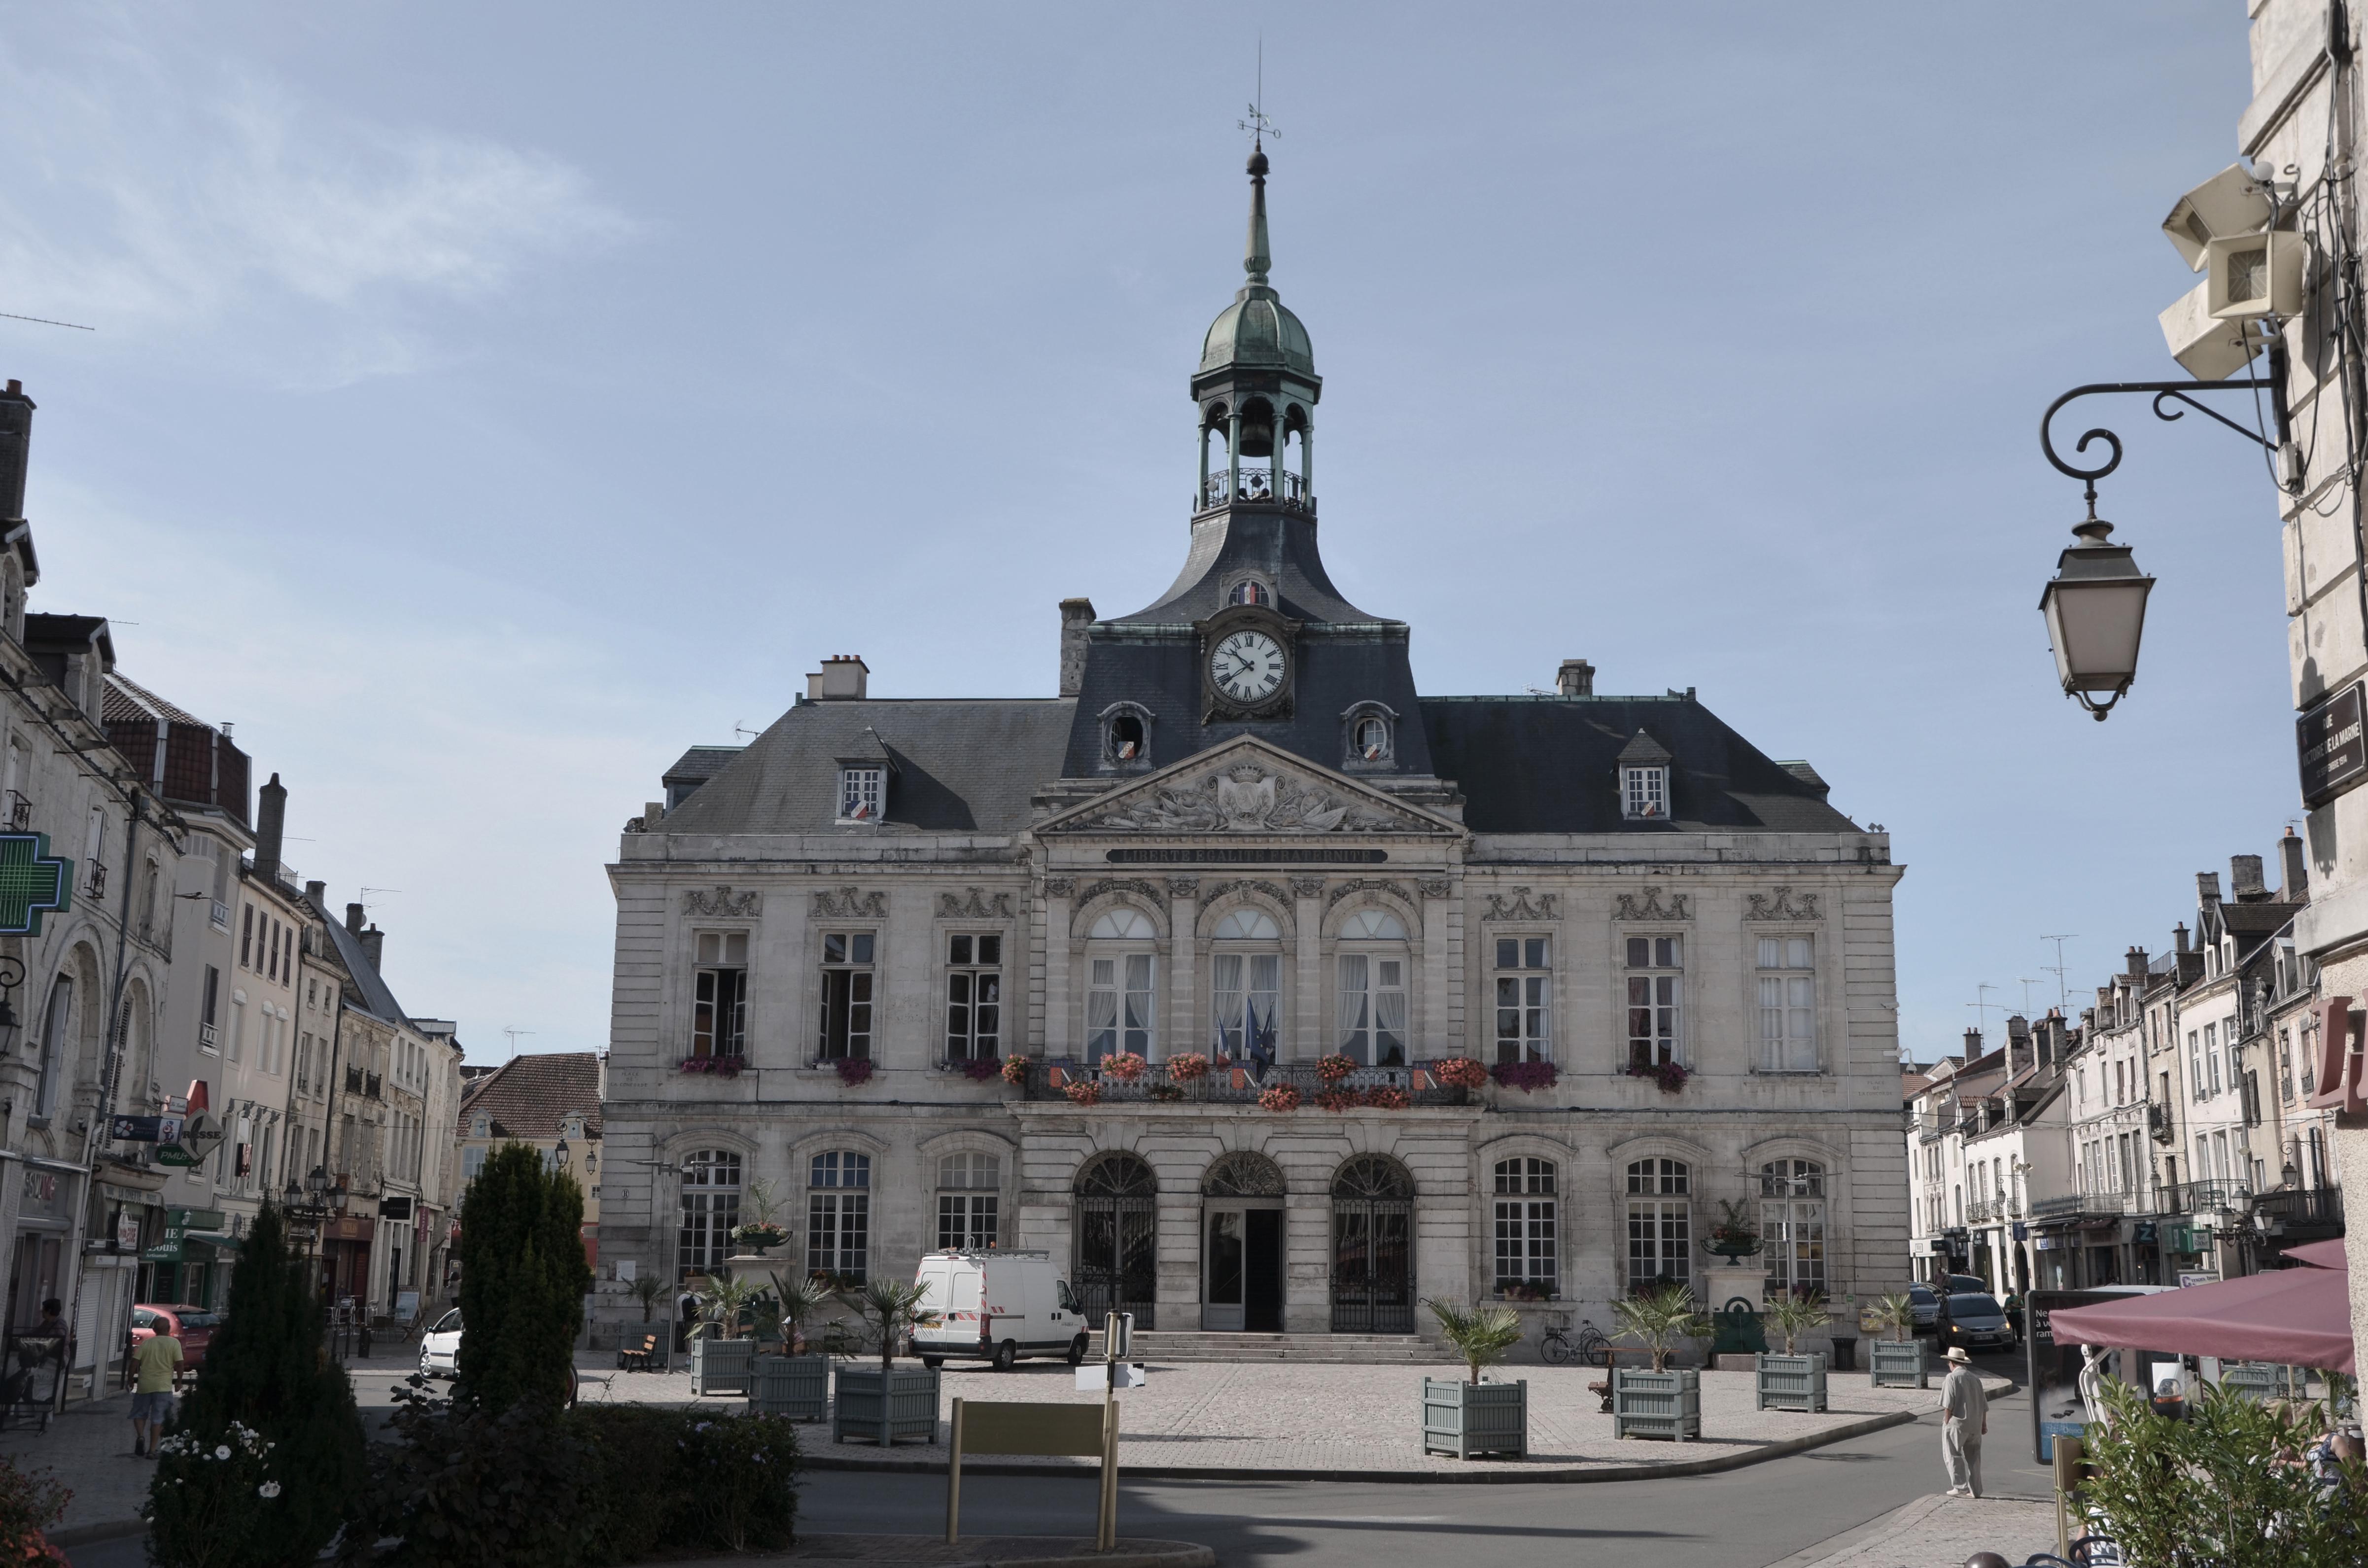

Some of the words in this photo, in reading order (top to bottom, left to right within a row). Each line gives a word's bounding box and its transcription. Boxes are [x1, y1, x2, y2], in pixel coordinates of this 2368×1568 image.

[2322, 713, 2333, 731] RUE
[2302, 741, 2325, 767] VICTOIRE
[2324, 737, 2332, 755] DE
[2332, 733, 2340, 750] LA
[2339, 721, 2360, 746] MARNE
[1122, 850, 1190, 862] LIBERTE
[1196, 850, 1264, 862] EGALITE
[1270, 850, 1370, 862] FRATERNITE
[182, 1131, 221, 1139] RESSE
[160, 1151, 183, 1160] PMU
[2139, 1227, 2154, 1241] Z
[2035, 1309, 2048, 1318] Ne
[2036, 1319, 2041, 1327] à
